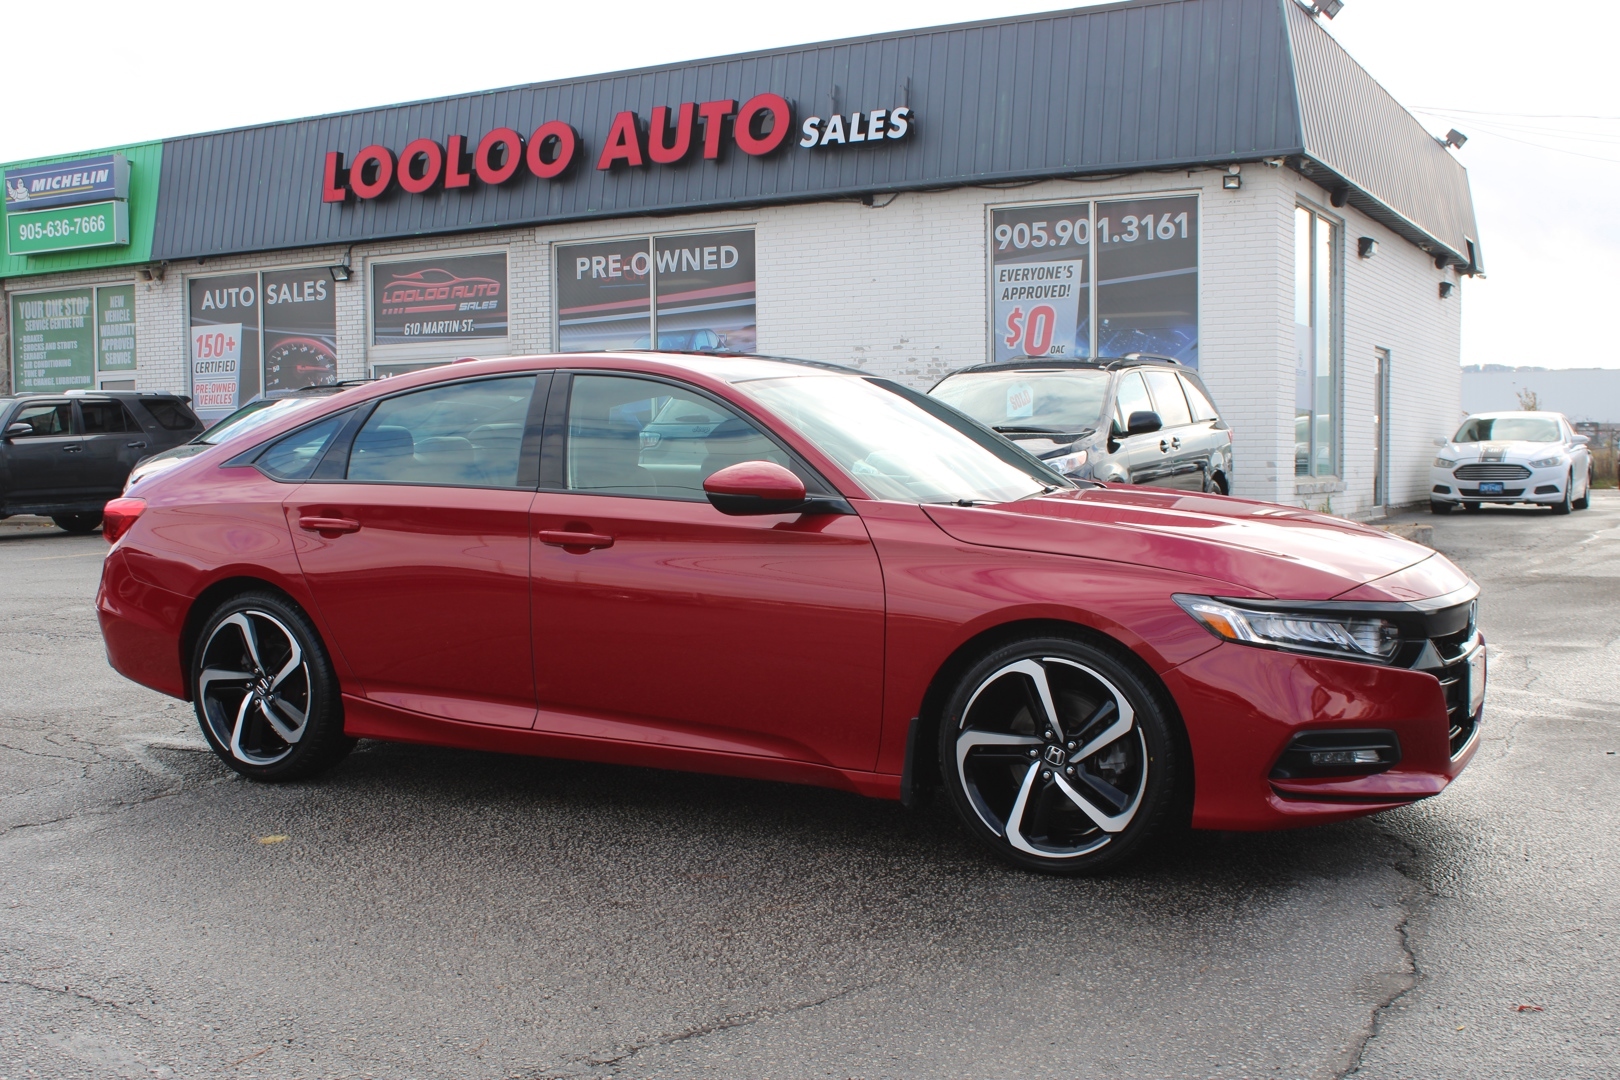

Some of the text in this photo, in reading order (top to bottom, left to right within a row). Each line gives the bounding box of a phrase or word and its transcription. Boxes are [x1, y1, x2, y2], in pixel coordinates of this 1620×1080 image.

[323, 92, 911, 204] LOOLOO AUTO SALES
[31, 169, 109, 192] MICHELIN
[19, 215, 106, 240] 905-636-7666
[994, 211, 1189, 250] 905.901.3161
[576, 245, 739, 280] PRE-OWNED
[999, 265, 1073, 283] EVERYONE'S
[201, 279, 327, 311] AUTO SALES
[382, 283, 500, 304] LOOLOO AUTO
[1001, 284, 1071, 301] APPROVED!
[19, 296, 89, 320] YOUR ONE STOP
[109, 295, 125, 308] NEW
[458, 300, 498, 312] SALES
[104, 308, 130, 323] VEHICLE
[25, 316, 84, 332] SERVICE CENTRE FOR
[100, 323, 135, 337] WARRANTY
[404, 319, 474, 336] 610 MARTIN ST.
[1005, 305, 1065, 357] $0 OAC
[23, 334, 44, 343] BRAKES
[45, 342, 56, 351] AND
[56, 340, 78, 350] STRUTS
[101, 337, 134, 351] APPROVED
[195, 332, 236, 358] 150+
[23, 351, 47, 360] EXHAUST
[105, 351, 131, 365] SERVICE
[33, 359, 72, 369] CONDITIONING
[195, 359, 236, 374] CERTIFIED
[23, 369, 46, 378] TUNE UP
[55, 375, 91, 385] LUBRICATION
[195, 382, 236, 395] PRE-OWNED
[199, 393, 233, 406] VEHICLES
[1009, 389, 1031, 411] SOLD
